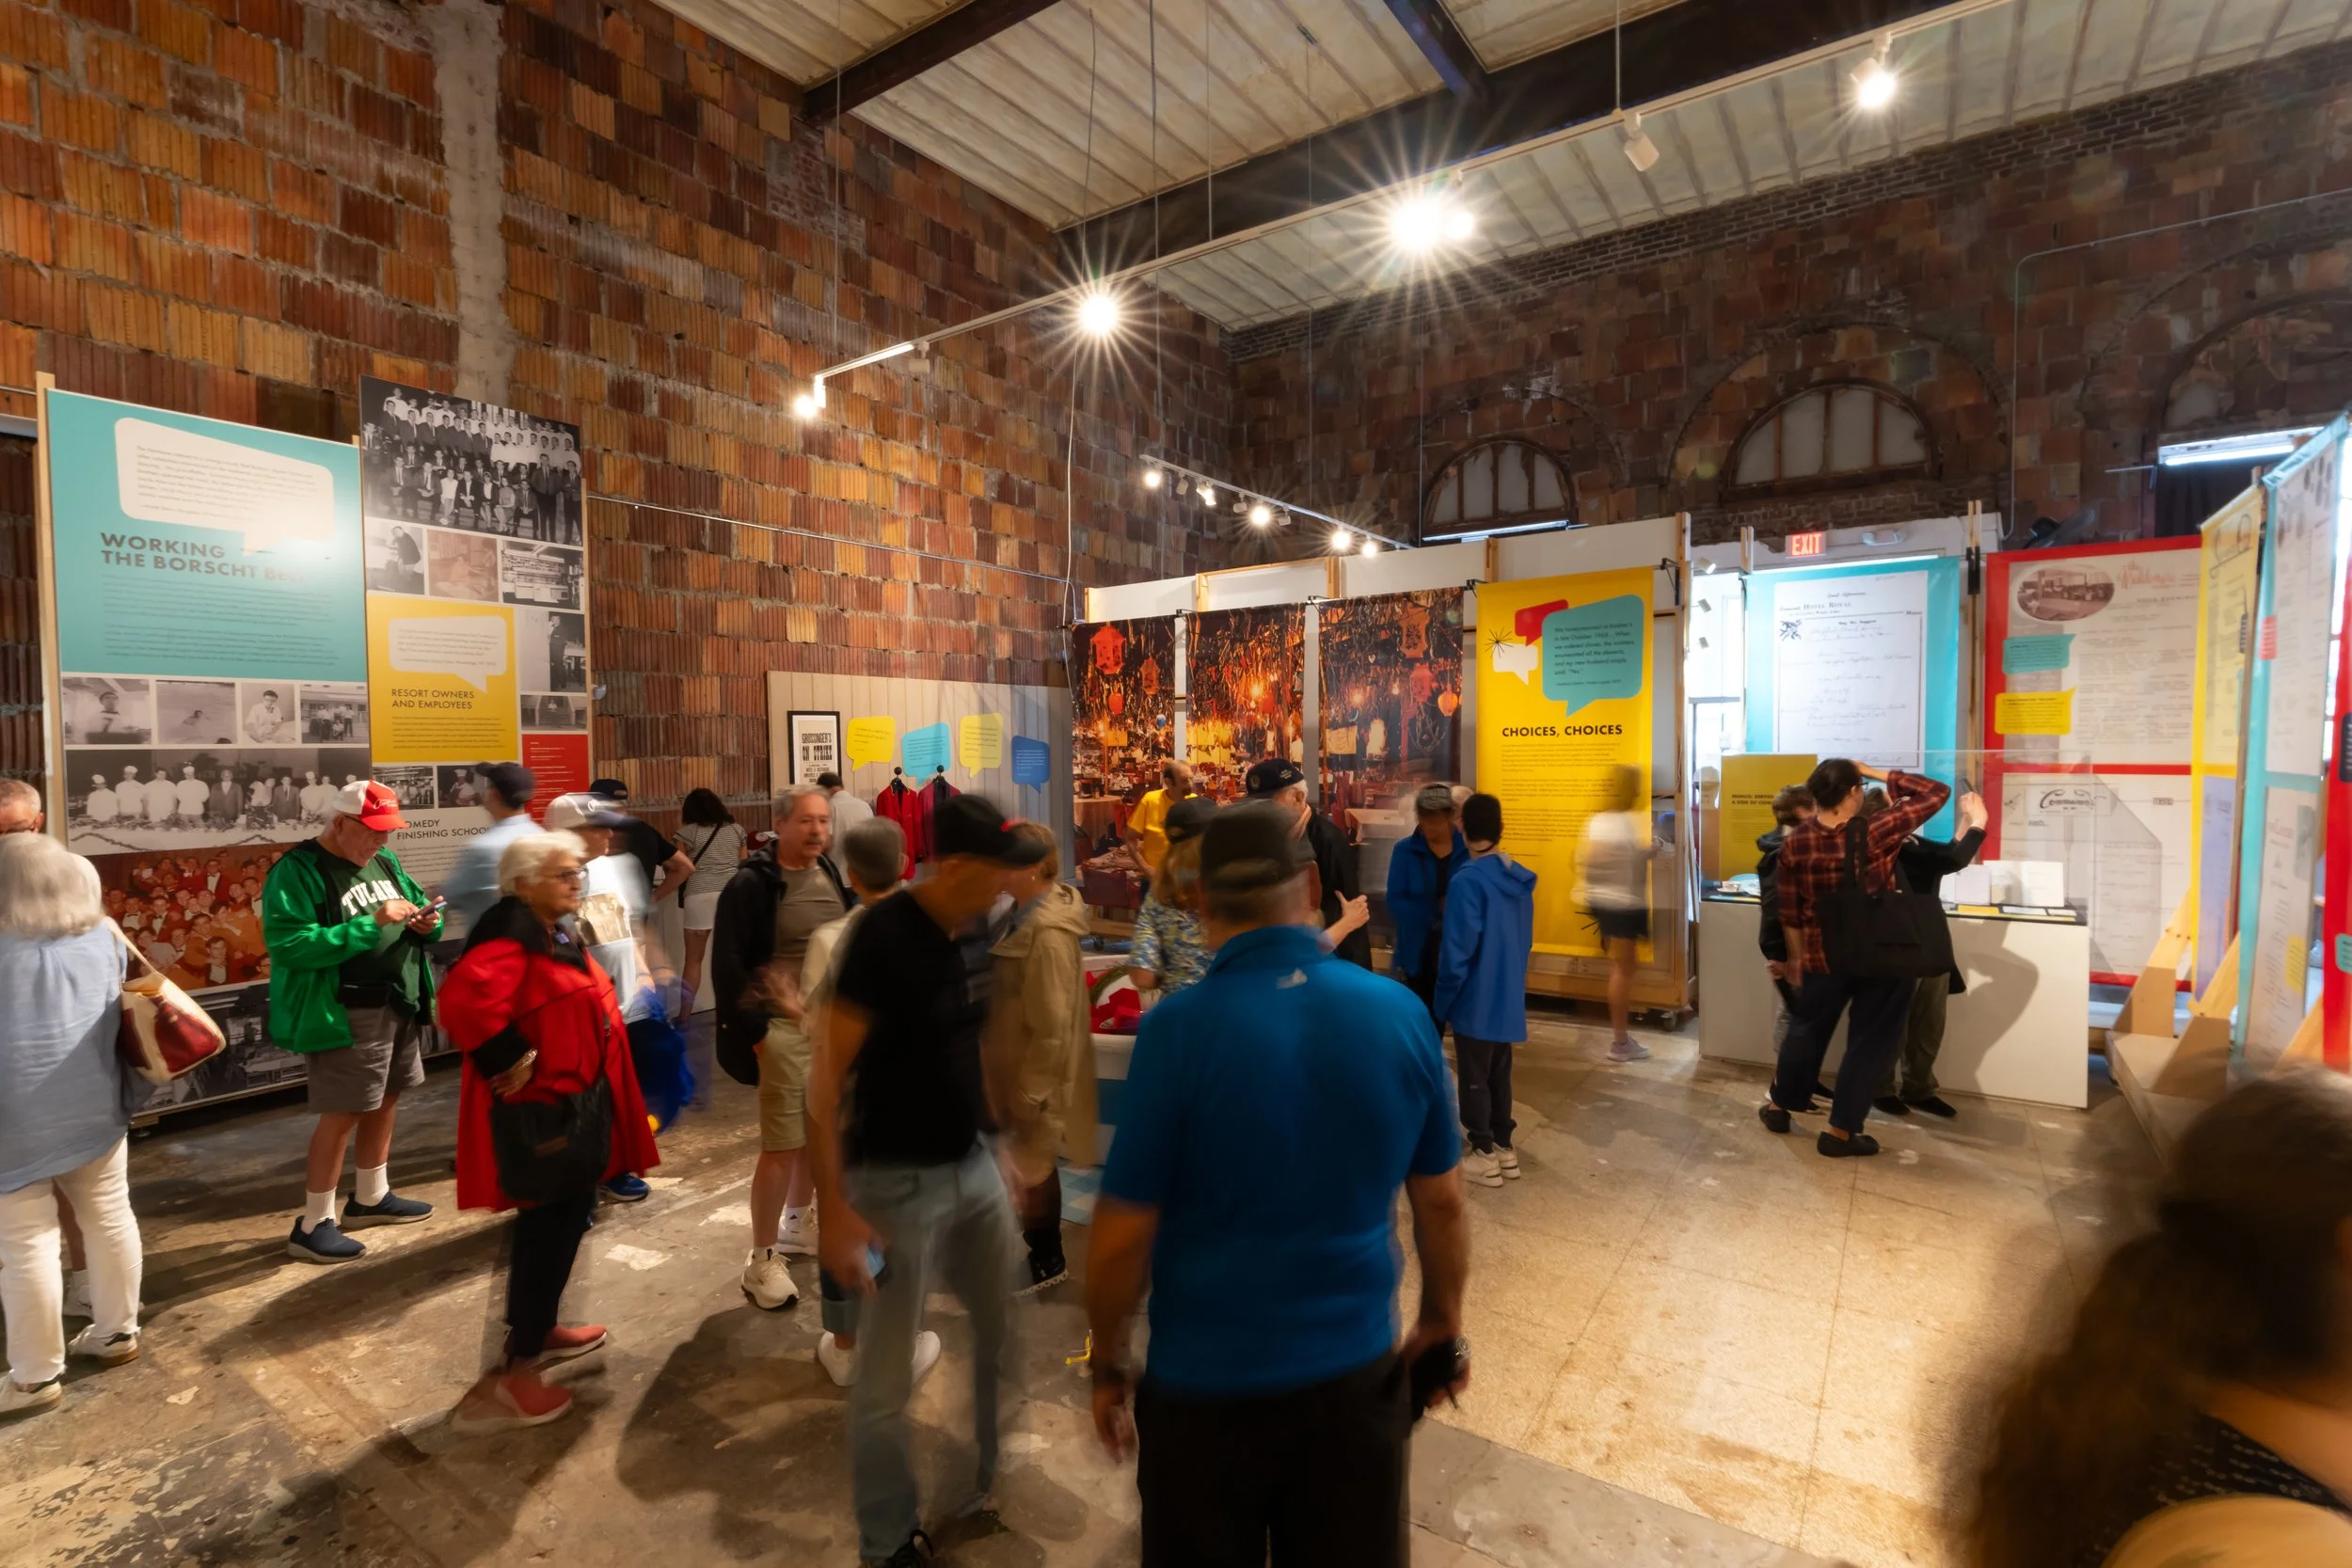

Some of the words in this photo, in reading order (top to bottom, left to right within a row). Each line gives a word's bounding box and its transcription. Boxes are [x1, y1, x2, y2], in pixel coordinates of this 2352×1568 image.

[101, 532, 226, 559] WORKING
[1791, 533, 1822, 556] EXIT
[101, 550, 146, 567] THE
[153, 554, 258, 578] BORSCHT
[391, 689, 428, 698] RESORT
[431, 689, 474, 699] OWNERS
[391, 700, 415, 708] AND
[418, 701, 472, 709] EMPLOYEES
[1502, 726, 1560, 737] CHOICES,
[1564, 724, 1623, 736] CHOICES
[402, 819, 440, 829] OMEDY
[396, 829, 449, 841] FINISHING
[341, 879, 405, 916] TULAN
